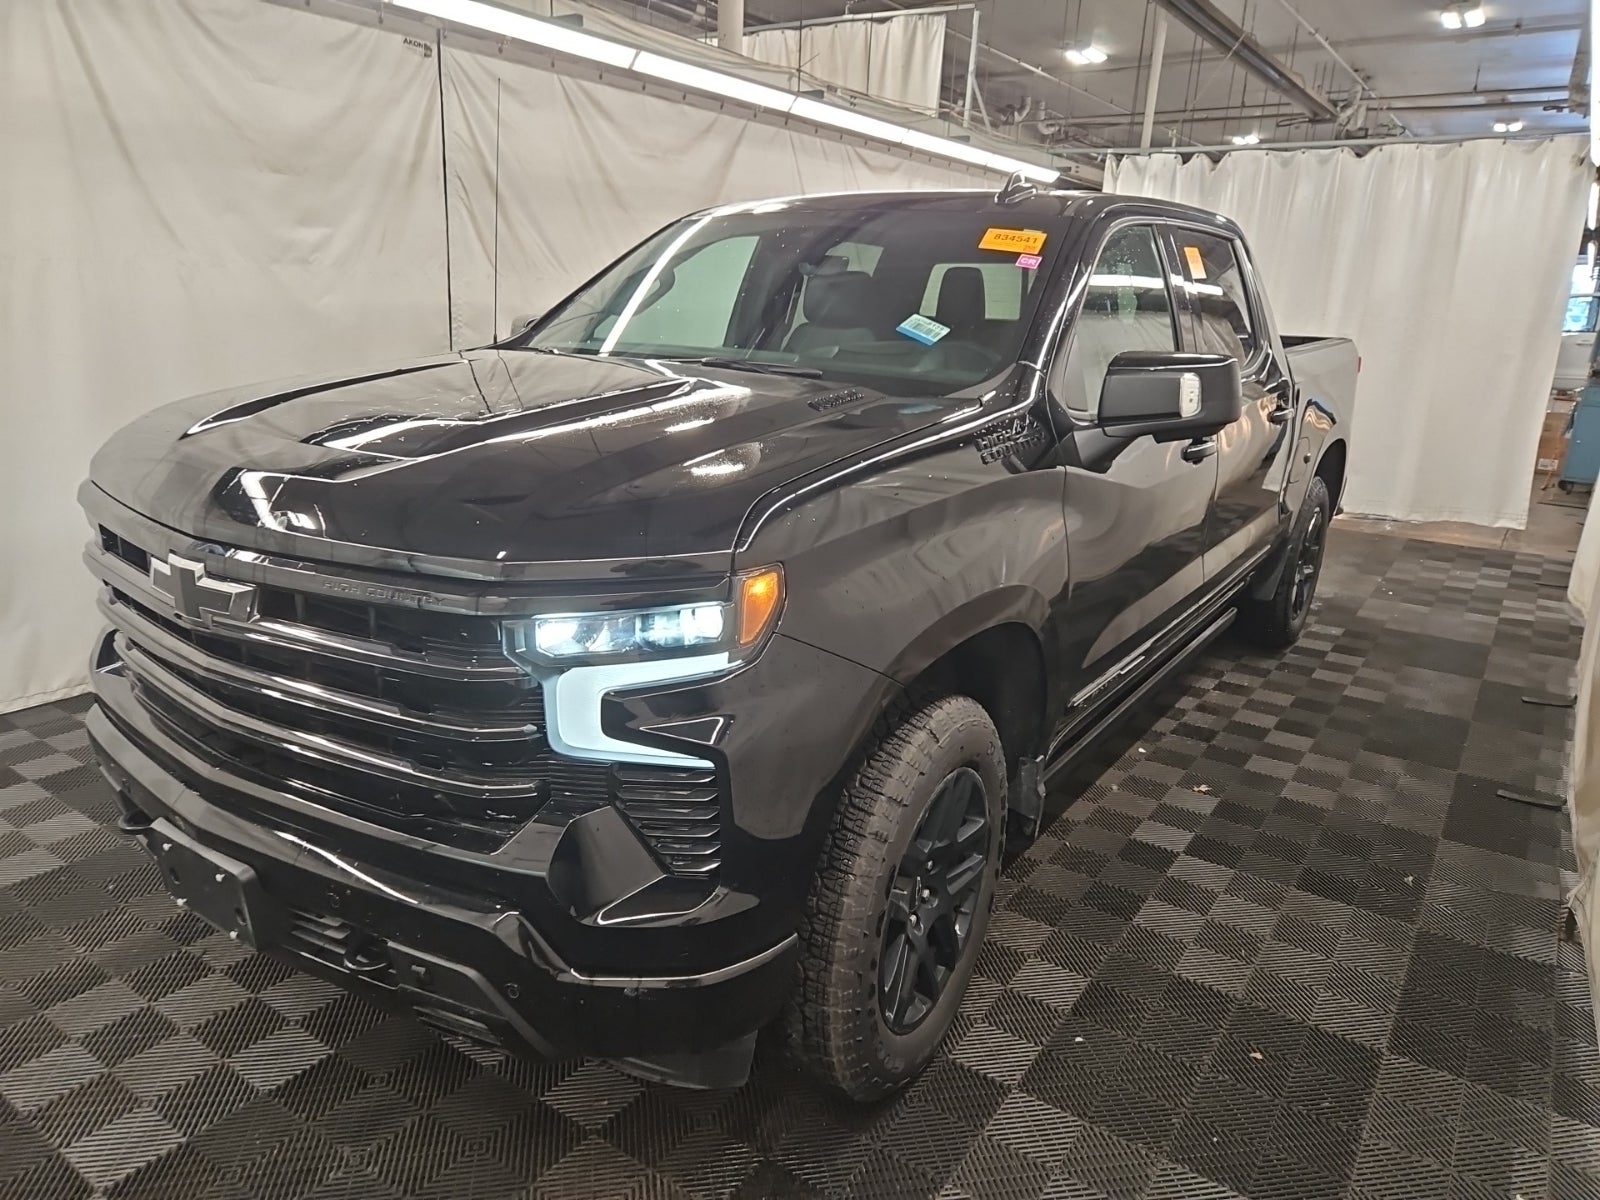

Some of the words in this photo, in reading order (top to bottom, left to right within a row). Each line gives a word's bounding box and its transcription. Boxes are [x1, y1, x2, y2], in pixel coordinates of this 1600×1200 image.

[993, 233, 1038, 244] 834541
[1020, 257, 1036, 266] CR
[975, 428, 1013, 452] HIGH
